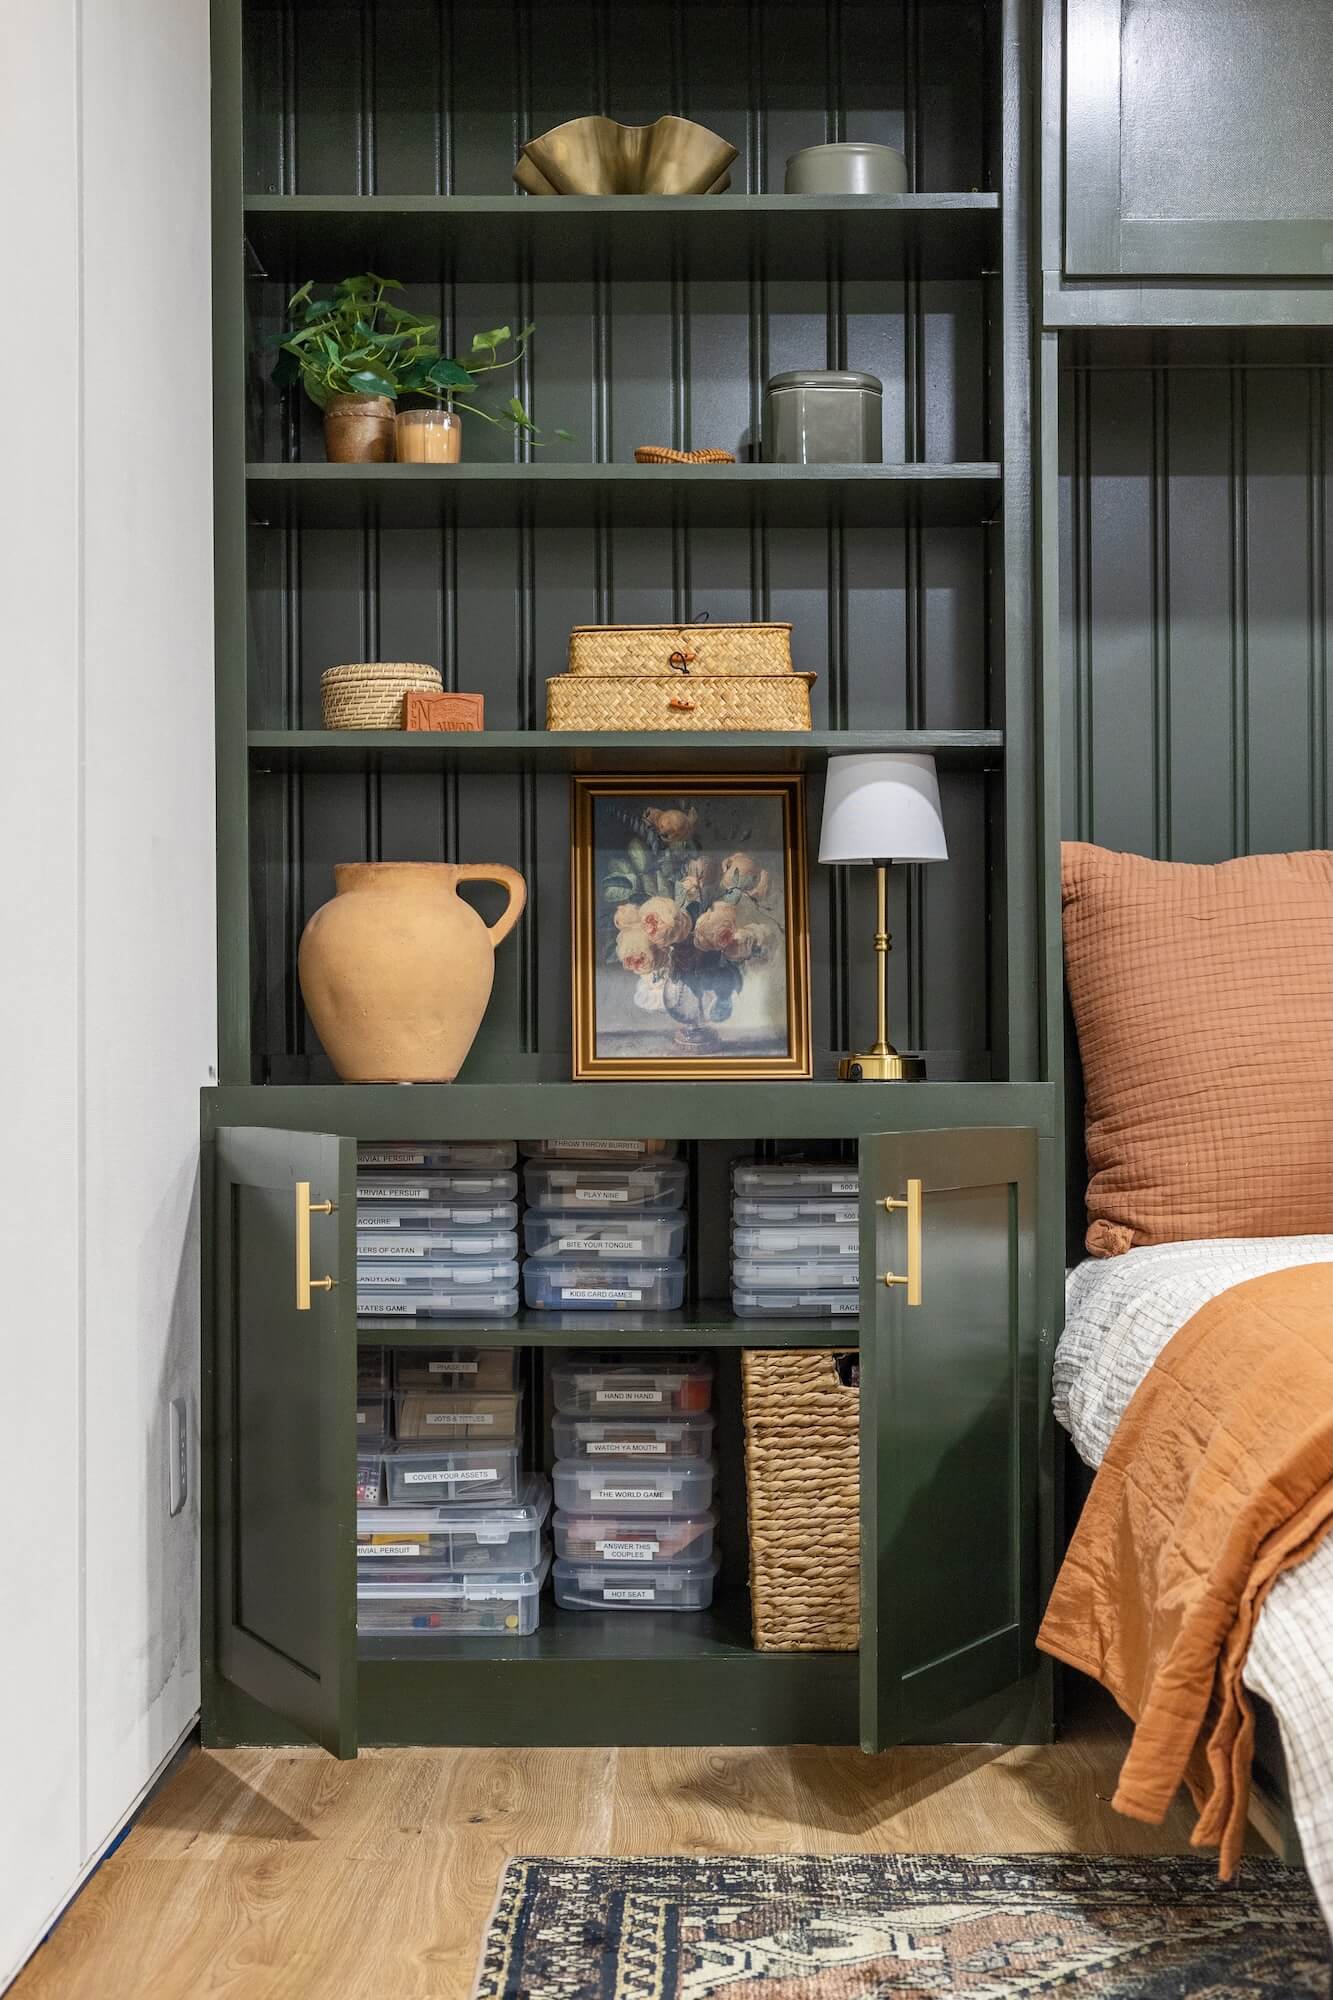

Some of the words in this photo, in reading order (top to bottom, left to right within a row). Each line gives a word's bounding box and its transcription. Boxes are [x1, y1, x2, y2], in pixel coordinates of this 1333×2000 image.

[554, 1140, 579, 1148] THROW
[581, 1141, 607, 1149] THROW
[608, 1142, 639, 1150] BURRITO
[389, 1189, 421, 1197] PERSUIT
[440, 1472, 459, 1480] YOUR
